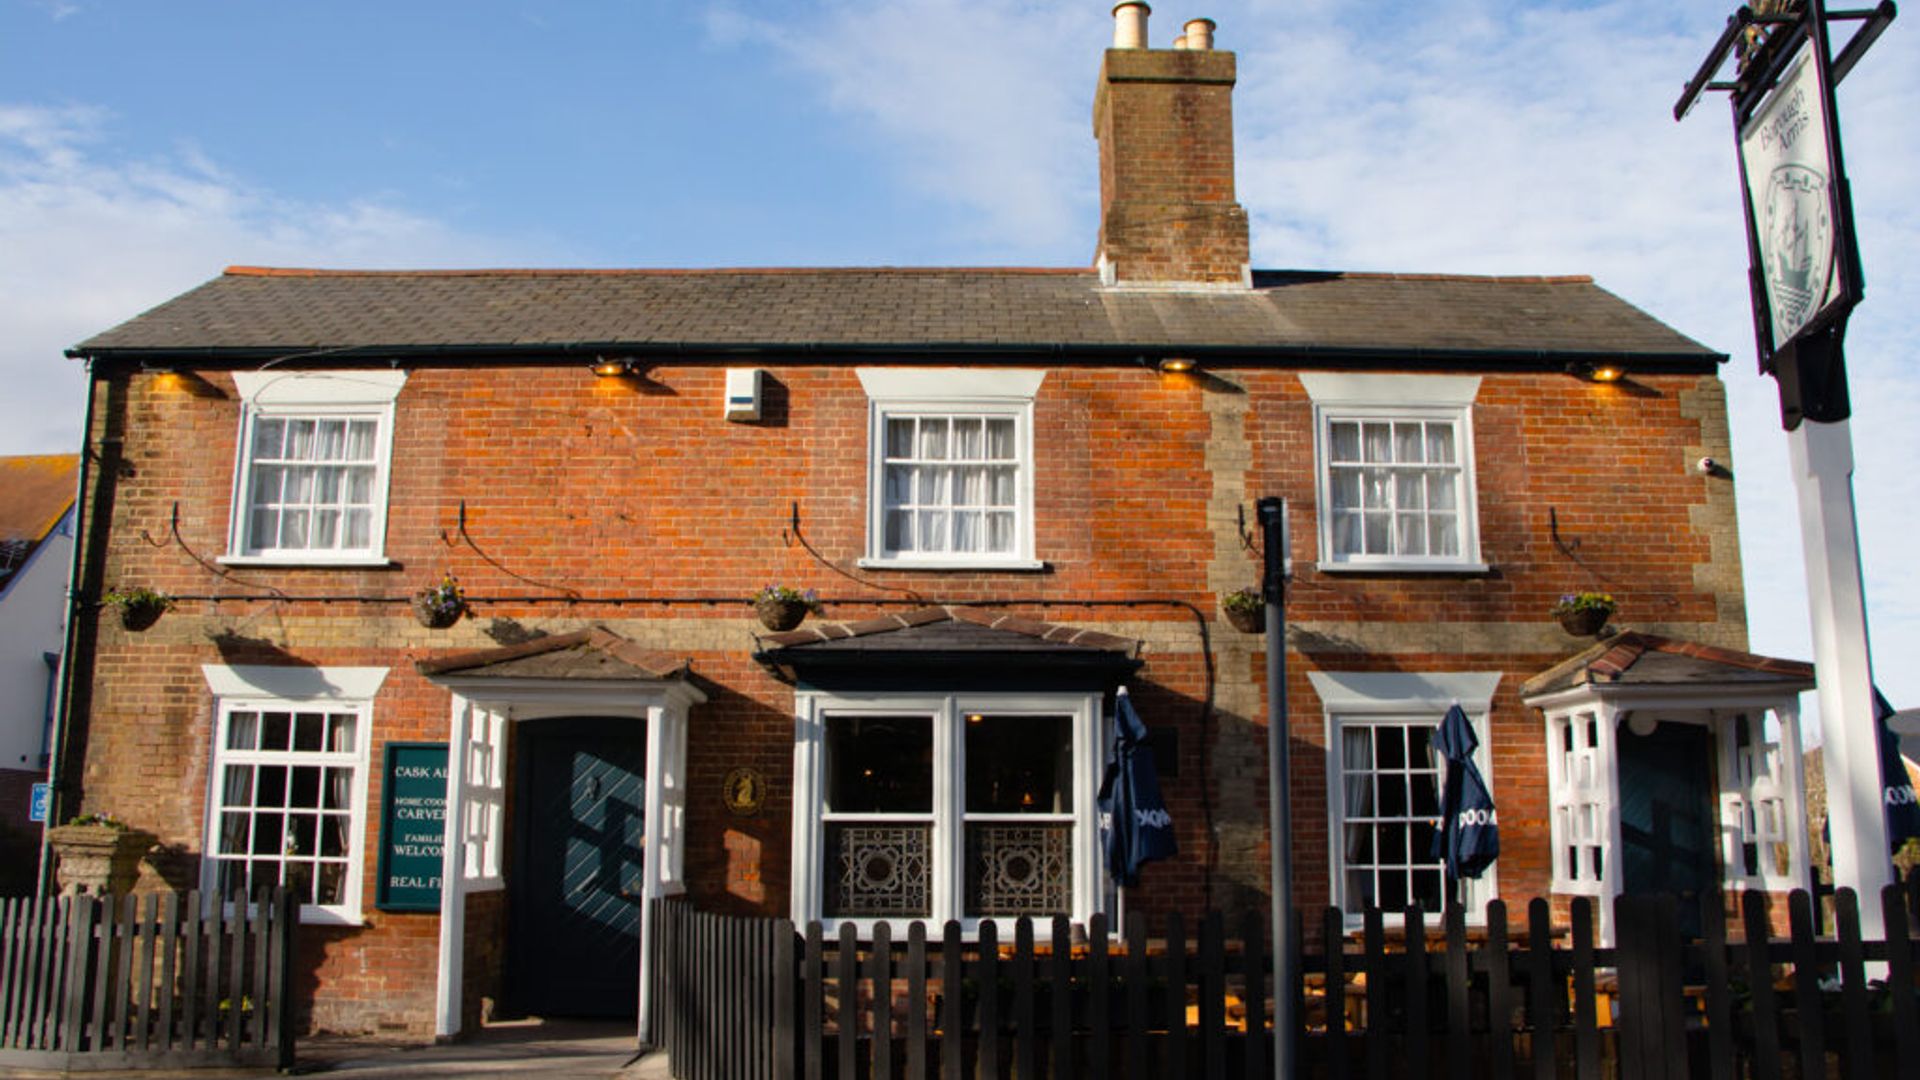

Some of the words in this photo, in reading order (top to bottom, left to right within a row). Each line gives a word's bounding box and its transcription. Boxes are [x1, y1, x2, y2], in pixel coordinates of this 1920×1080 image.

[1760, 88, 1805, 151] Borough
[1779, 112, 1808, 151] Arms
[395, 767, 429, 778] CASK
[390, 876, 426, 889] REAL
